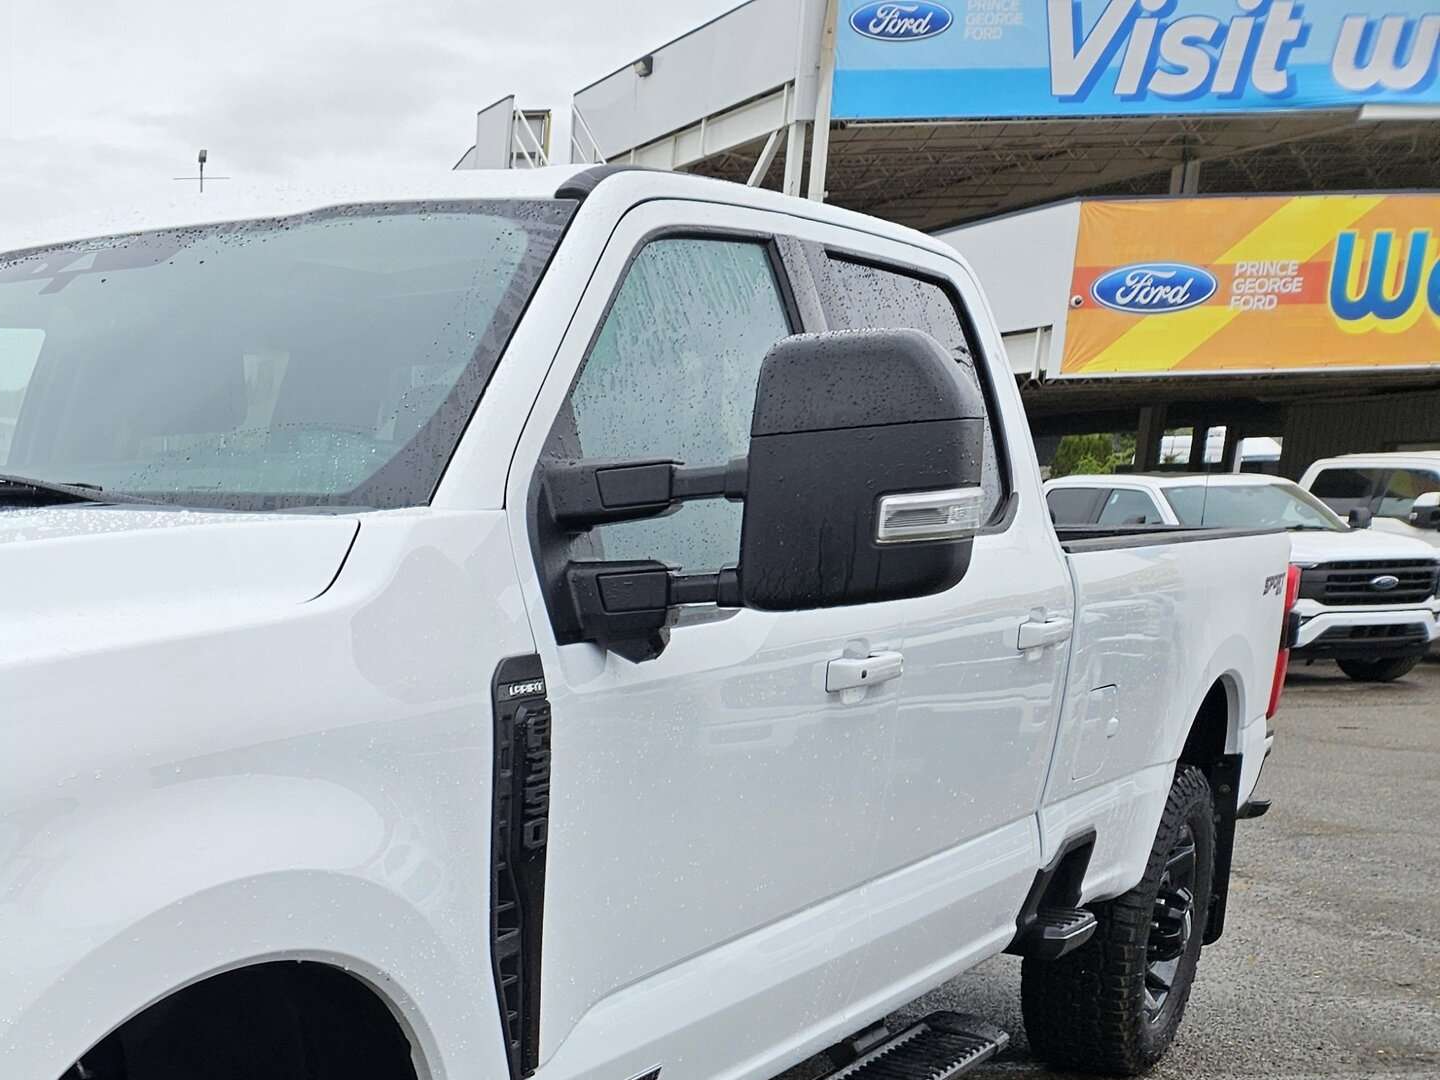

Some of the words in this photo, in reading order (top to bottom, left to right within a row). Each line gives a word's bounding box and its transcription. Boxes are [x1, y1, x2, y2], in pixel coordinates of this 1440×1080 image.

[868, 3, 934, 35] Ford
[965, 12, 1024, 25] GEORGE
[964, 27, 1002, 40] FORD
[1046, 0, 1305, 97] Visit
[1234, 260, 1298, 276] PRINCE
[1114, 269, 1195, 305] Ford
[1232, 277, 1304, 293] GEORGE
[1229, 295, 1278, 311] FORD
